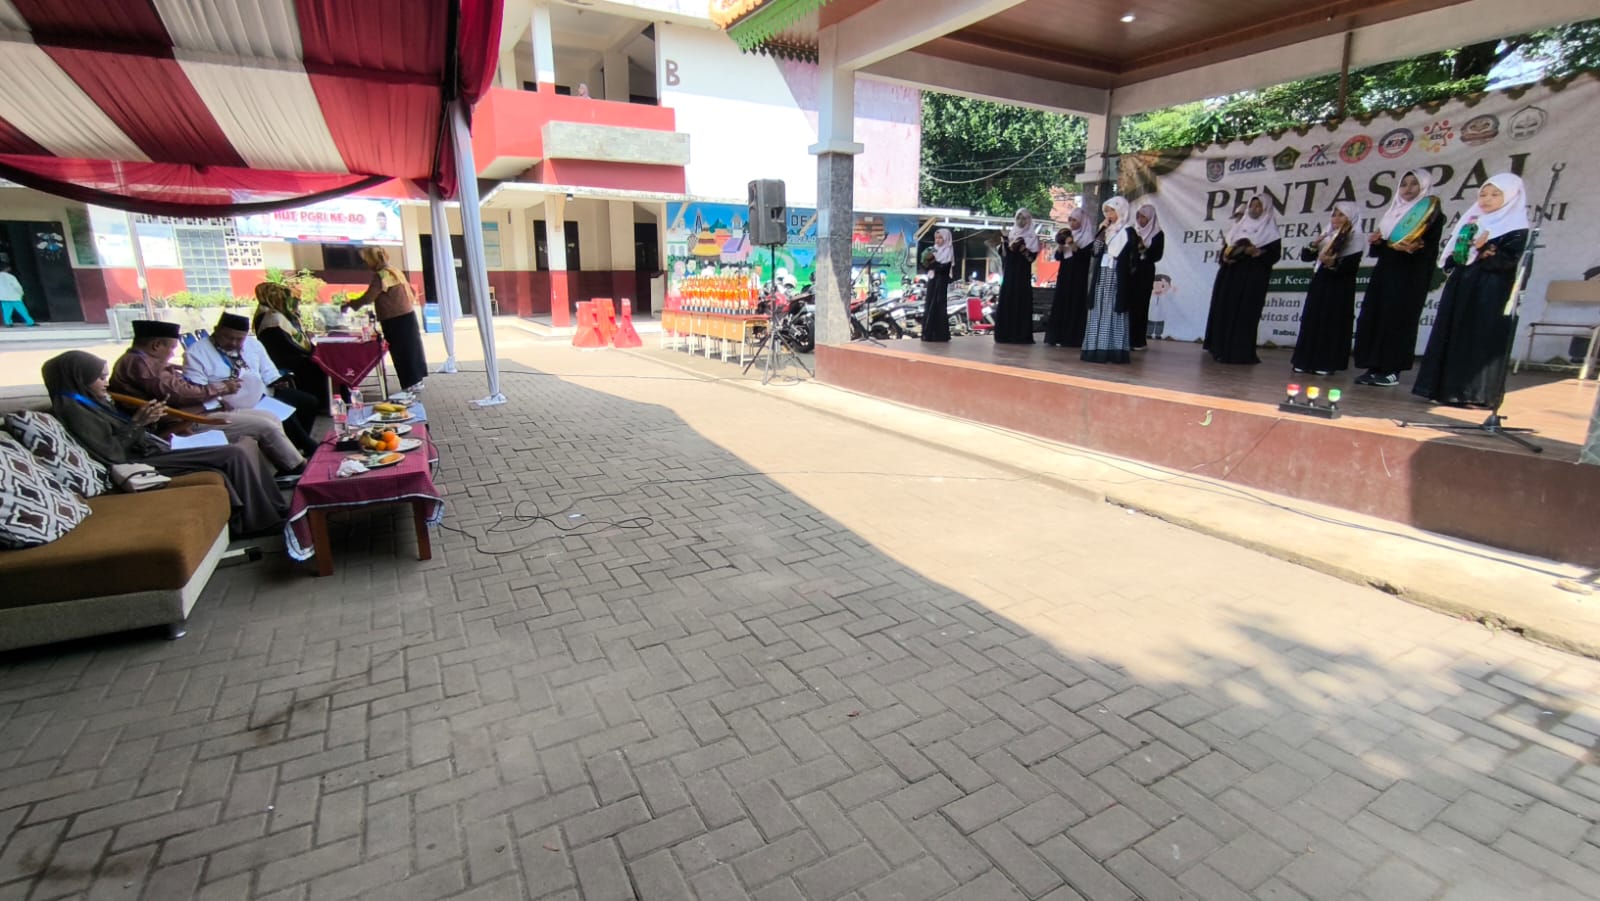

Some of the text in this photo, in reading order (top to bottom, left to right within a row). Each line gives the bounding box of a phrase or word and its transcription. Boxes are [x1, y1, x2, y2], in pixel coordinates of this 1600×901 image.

[665, 59, 680, 86] B
[273, 209, 297, 221] HUT
[1183, 229, 1225, 244] PEKA
